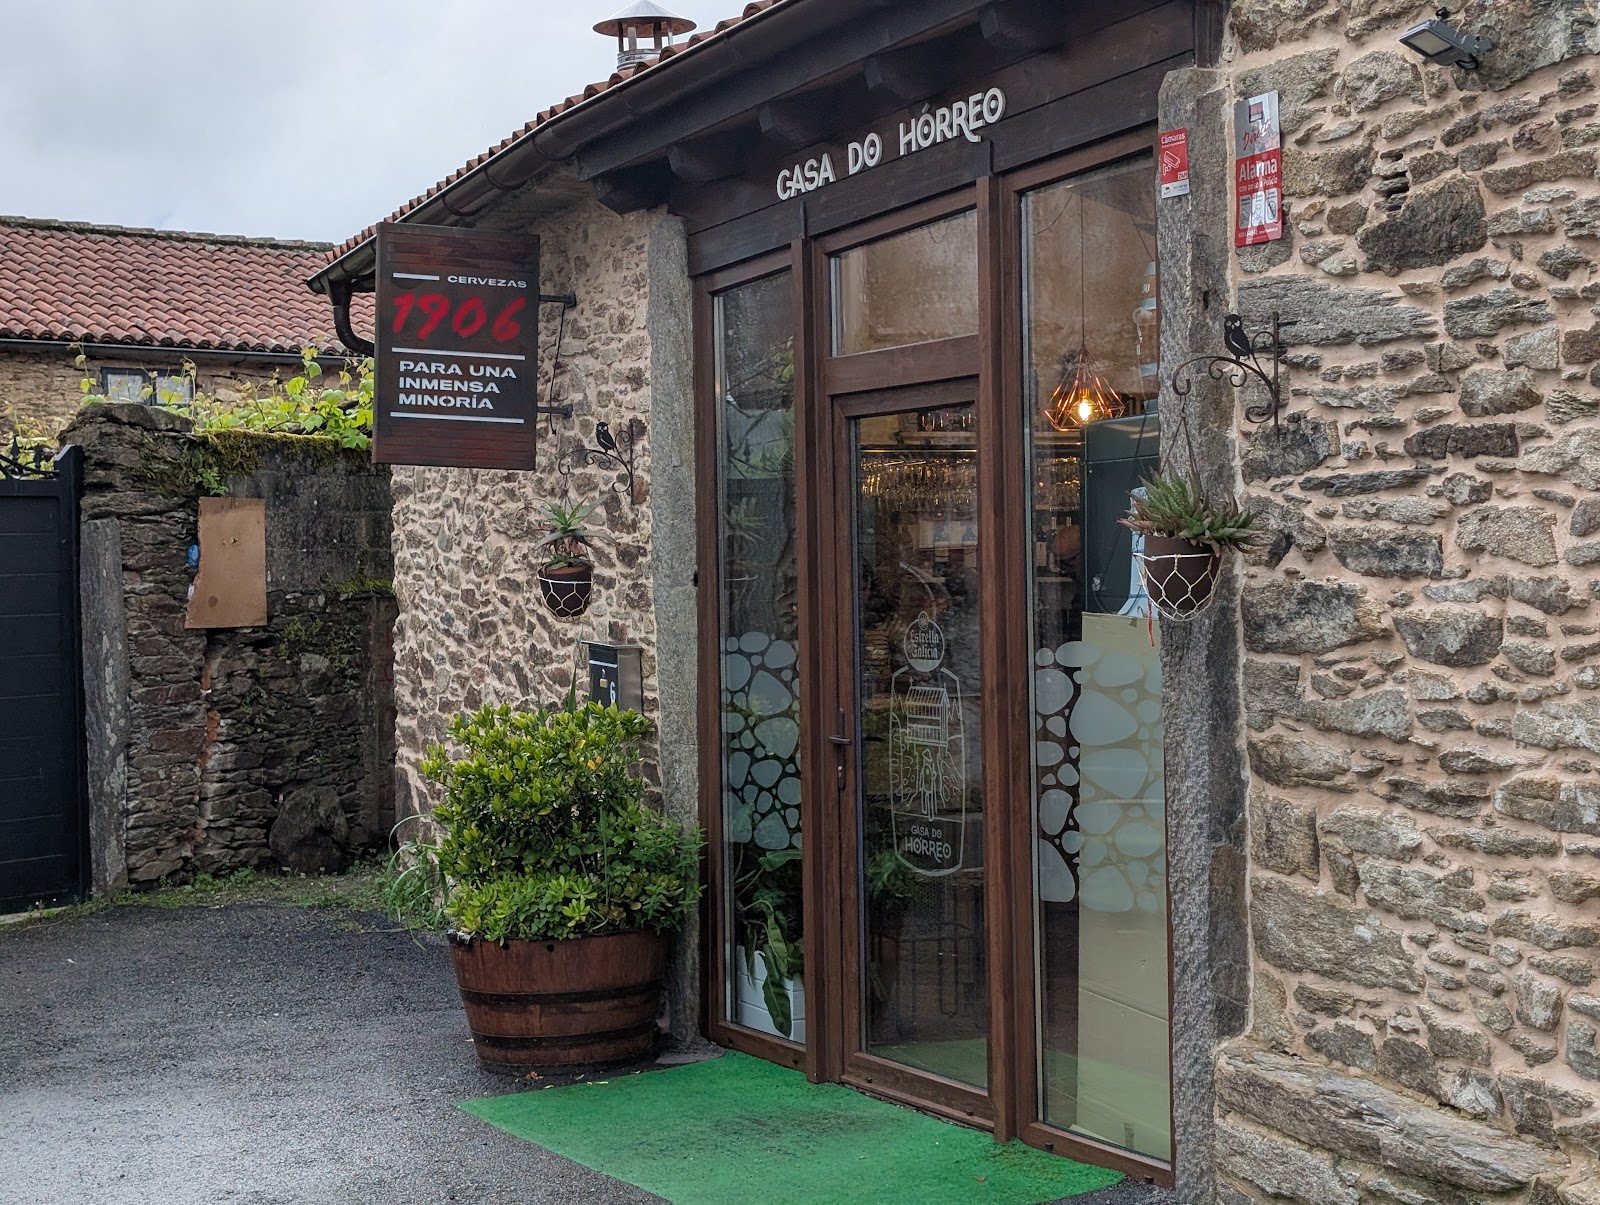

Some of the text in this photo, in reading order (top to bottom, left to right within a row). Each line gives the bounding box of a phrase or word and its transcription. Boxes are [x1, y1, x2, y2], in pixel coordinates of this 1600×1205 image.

[776, 87, 1007, 200] CASA DO HÓRREO
[1161, 132, 1186, 145] Cámaras
[1239, 158, 1278, 182] Alarma
[447, 275, 527, 289] CERVEZAS
[391, 291, 527, 342] 1906
[399, 360, 517, 379] PARA UNA
[399, 377, 501, 394] INMENSA
[398, 393, 494, 410] MINORÍA
[910, 629, 940, 644] Estrella
[911, 643, 939, 659] Galicia
[609, 681, 616, 703] 6
[911, 825, 942, 839] CASA DO
[905, 836, 952, 863] HÓRREO
